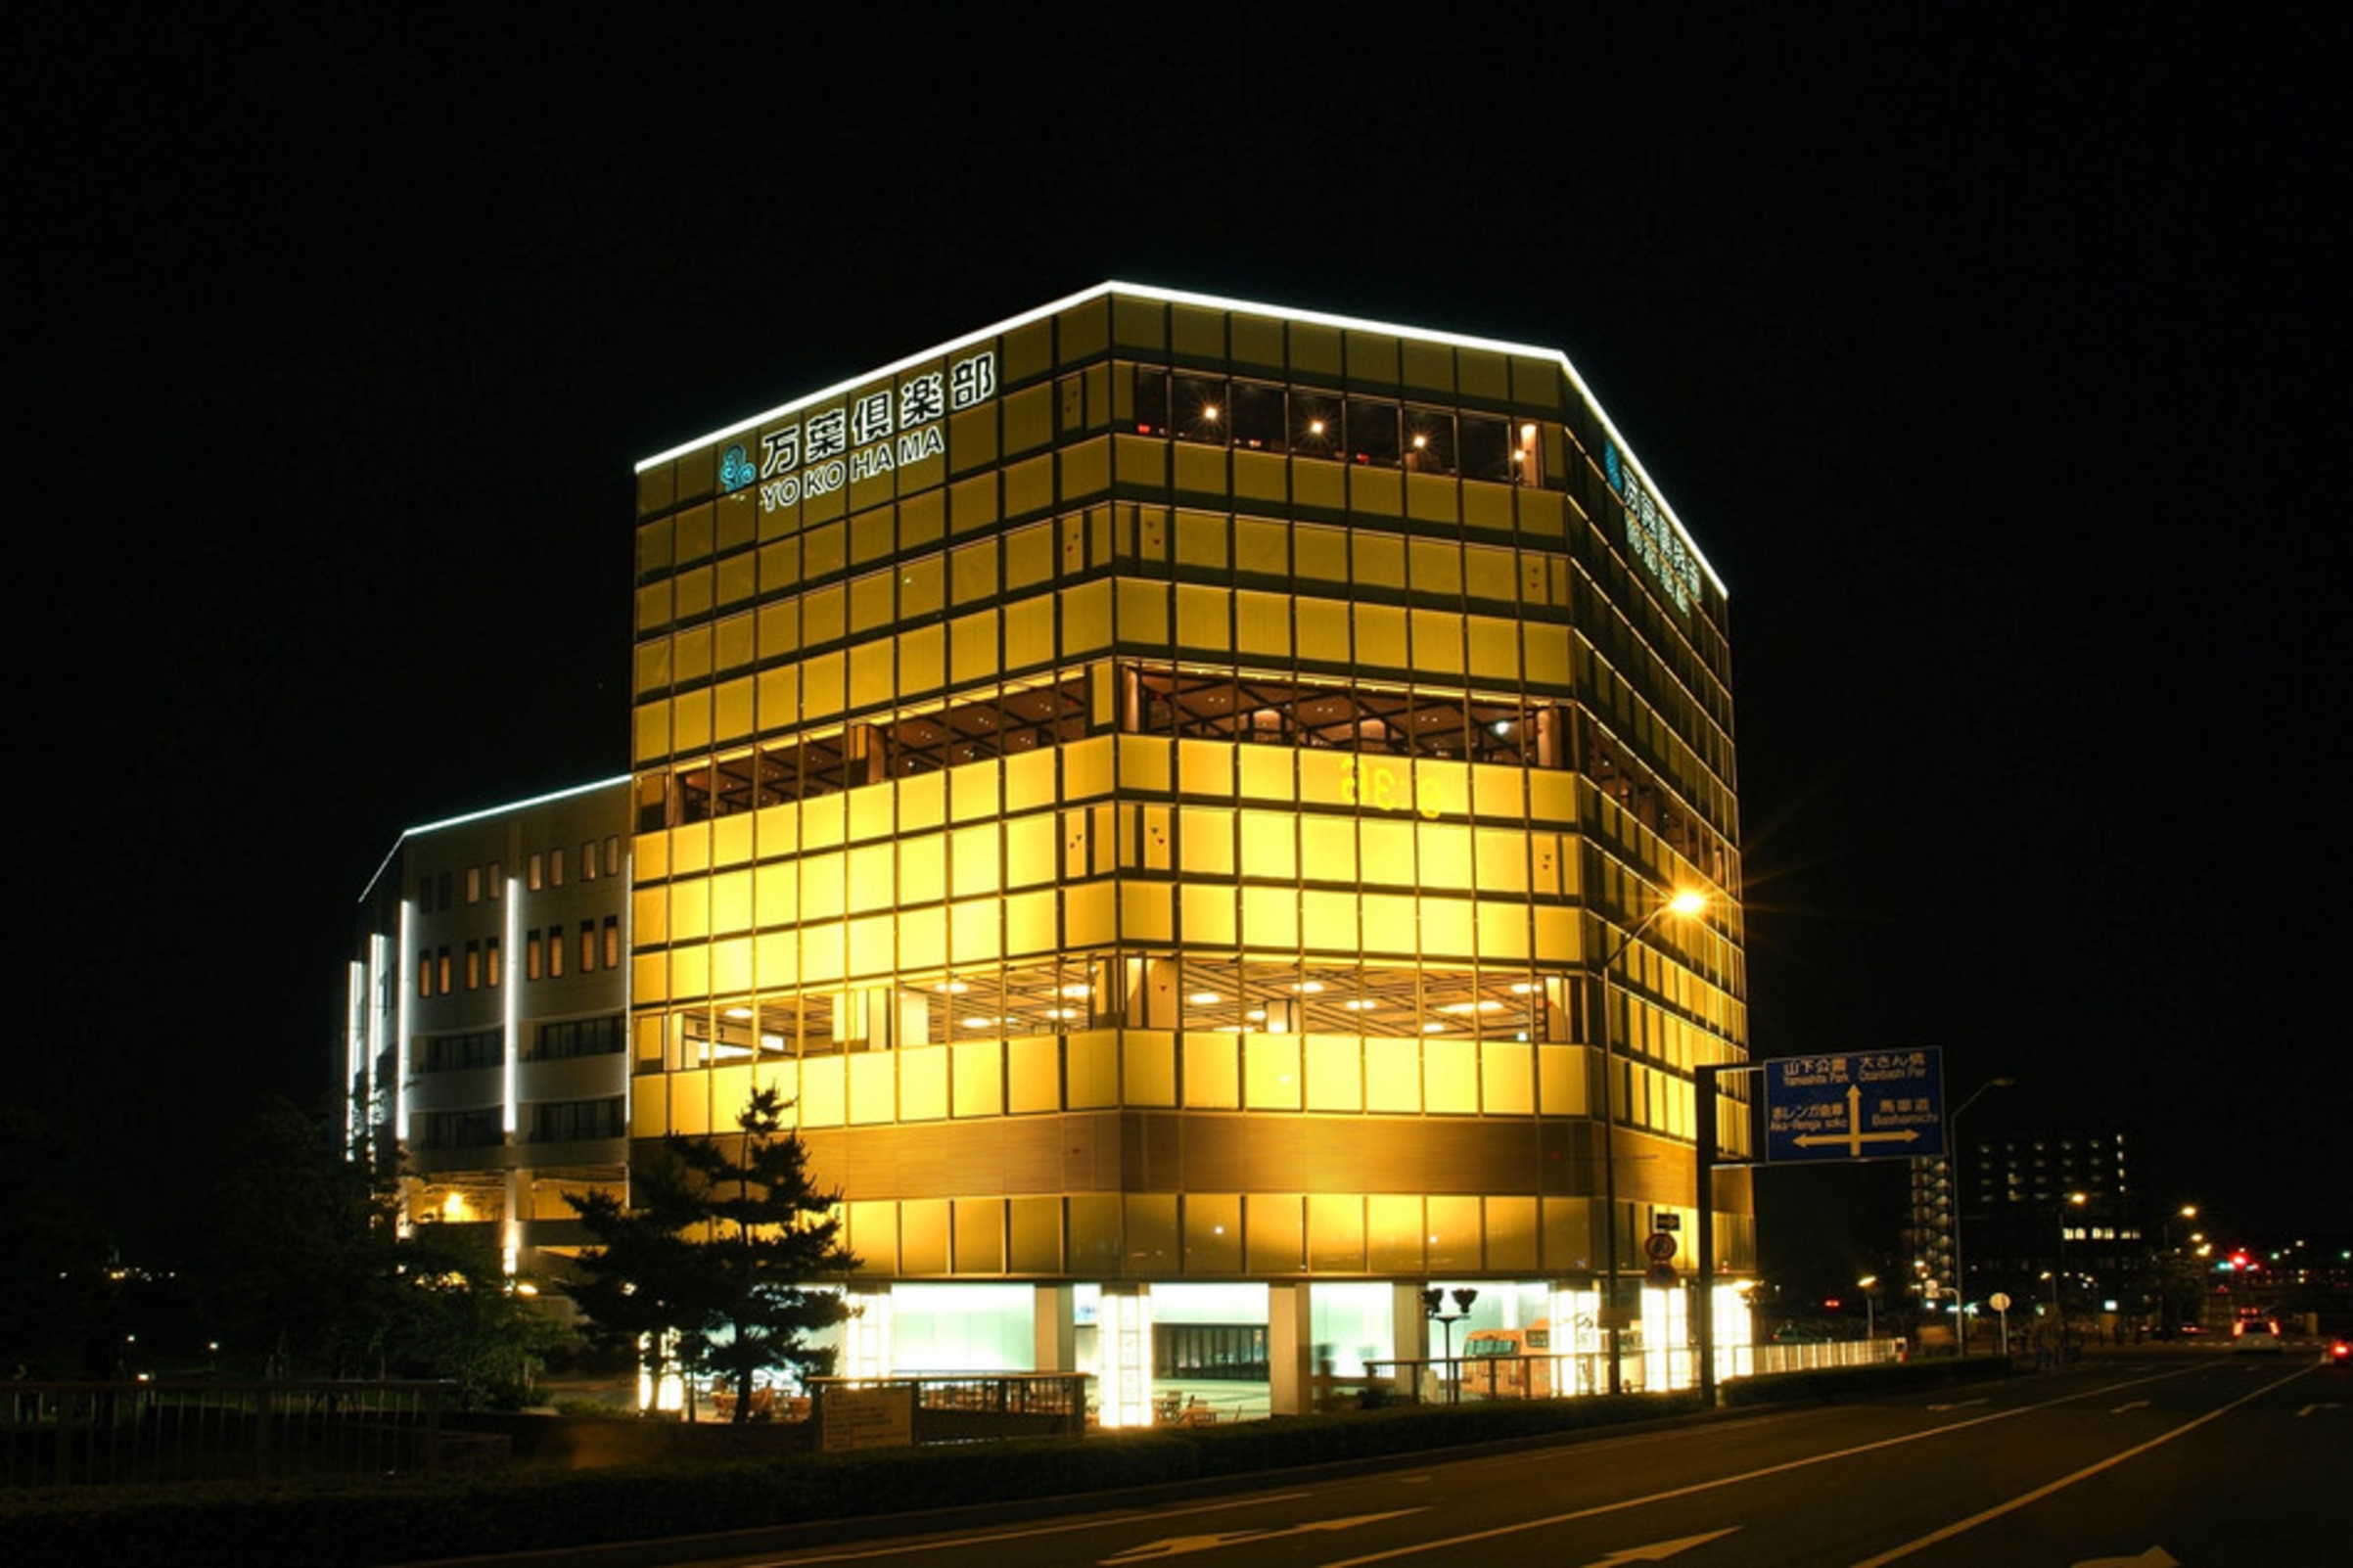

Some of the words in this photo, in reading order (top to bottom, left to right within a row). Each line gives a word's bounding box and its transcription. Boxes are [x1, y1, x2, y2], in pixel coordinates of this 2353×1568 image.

[761, 351, 995, 479] 万葉倶楽部
